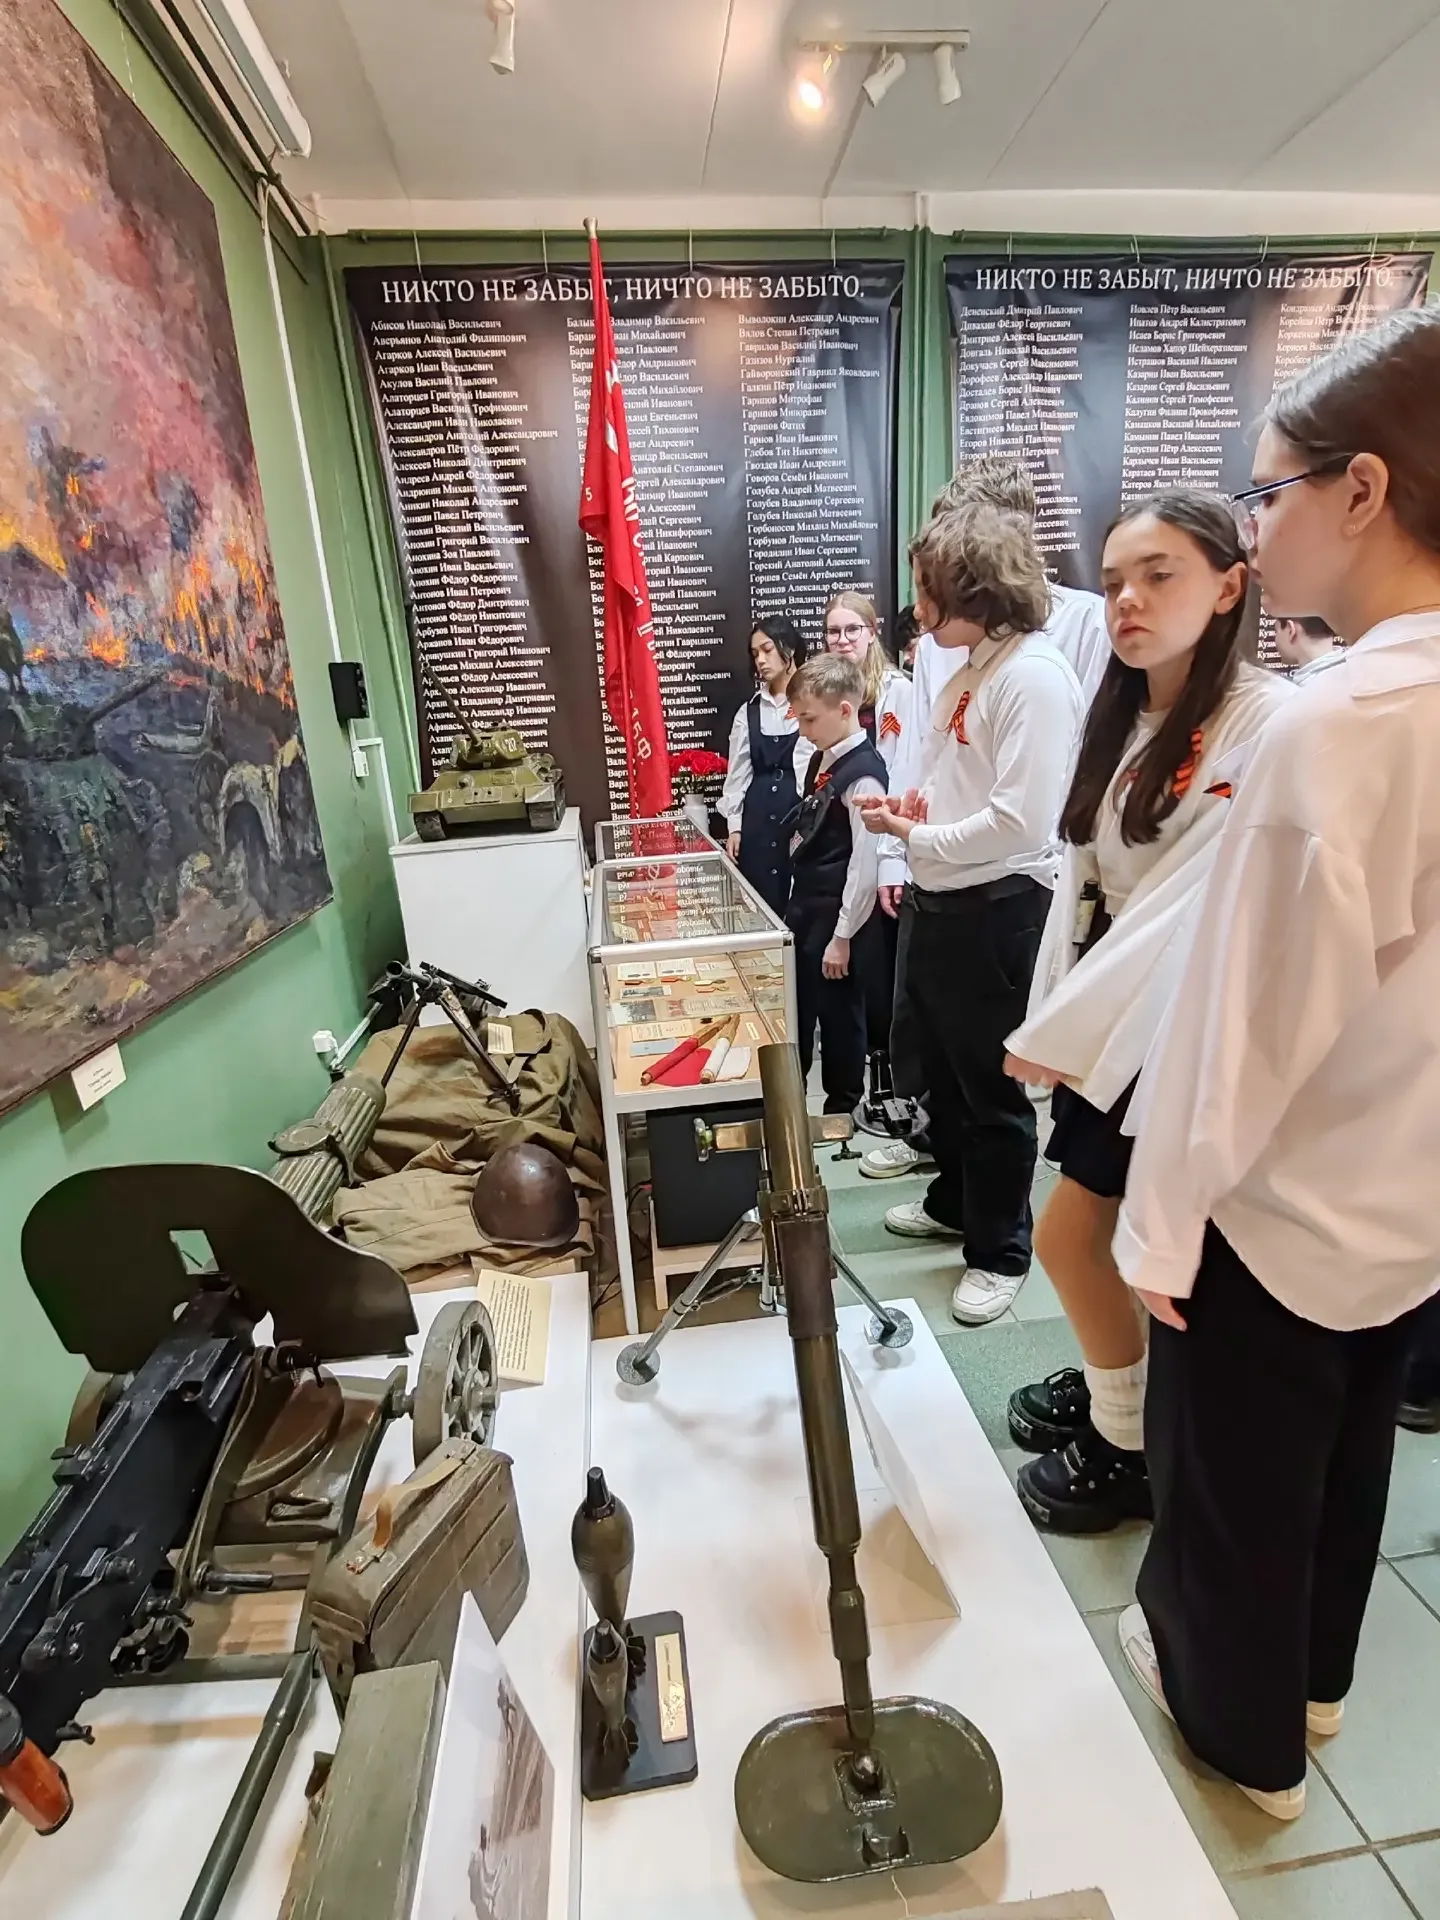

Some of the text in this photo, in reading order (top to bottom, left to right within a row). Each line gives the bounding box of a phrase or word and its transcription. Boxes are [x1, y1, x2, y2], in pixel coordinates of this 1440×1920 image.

[976, 267, 1393, 292] НИКТО НЕ ЗАБЫТ, НИЧТО НЕ ЗАБЫТО.
[382, 280, 474, 303] НИКТО
[482, 280, 517, 300] НЕ
[625, 277, 712, 300] НИЧТО
[721, 277, 752, 298] НЕ
[759, 275, 864, 298] ЗАБЫТО.
[1160, 304, 1179, 315] Пётр
[1181, 305, 1225, 314] Васильевич
[655, 315, 705, 326] Васильевич
[789, 314, 834, 323] Александр
[836, 313, 879, 325] Андреевич
[1159, 319, 1188, 328] Андрей
[371, 320, 501, 331] Абисов Николай Васильевич
[631, 330, 685, 340] Михайлович
[767, 327, 797, 337] Степан
[800, 327, 839, 337] Петрович
[1129, 331, 1225, 341] Исаев Борис Григорьевич
[373, 333, 526, 347] Аверьянов Анатолий Филиппович
[960, 334, 1000, 344] Дмитриев
[637, 345, 678, 354] Павлович
[740, 340, 858, 353] Гаврилов Василий Иванович
[995, 346, 1030, 355] Николай
[1032, 346, 1077, 354] Васильевич
[375, 349, 506, 362] Агарков Алексей Васильевич
[378, 362, 493, 375] Агарков Иван Васильевич
[639, 359, 696, 369] Андрианович
[960, 359, 1078, 372] Докучаев Сергей Максимович
[640, 373, 689, 381] Васильевич
[802, 368, 837, 378] Гавриил
[839, 367, 880, 377] Яковлевич
[380, 376, 498, 390] Акулов Василий Павлович
[960, 372, 1082, 385] Дорофеев Александр Иванович
[650, 386, 703, 395] Михайлович
[774, 382, 794, 392] Пётр
[796, 381, 836, 389] Иванович
[1160, 382, 1185, 392] Сергей
[1186, 383, 1230, 391] Васильевич
[382, 390, 518, 404] Алаторцев Григорий Иванович
[651, 399, 693, 408] Иванович
[384, 403, 528, 418] Алаторцев Василий Трофимович
[445, 418, 468, 427] Иван
[470, 417, 522, 427] Николаевич
[650, 413, 698, 422] Евгеньевич
[654, 426, 699, 435] Тихонович
[388, 430, 558, 445] Александров Анатолий Александрович
[960, 436, 1061, 448] Егоров Николай Павлович
[648, 440, 693, 448] Андреевич
[1161, 444, 1179, 454] Пётр
[390, 444, 520, 458] Александров Пётр Фёдорович
[745, 447, 837, 457] Глебов Тит Никитович
[392, 458, 526, 471] Алексеев Николай Дмитриевич
[674, 464, 723, 472] Степанович
[394, 472, 514, 485] Андреев Андрей Фёдорович
[662, 477, 725, 486] Александрович
[746, 472, 848, 484] Говоров Семён Иванович
[746, 484, 857, 496] Голубев Андрей Матвеевич
[432, 499, 469, 508] Николай
[472, 498, 518, 507] Андреевич
[747, 496, 864, 510] Голубев Владимир Сергеевич
[659, 516, 701, 526] Сергеевич
[797, 523, 828, 532] Михаил
[831, 522, 878, 530] Михайлович
[656, 528, 712, 540] Никифорович
[403, 536, 530, 550] Анохин Григорий Васильевич
[405, 549, 501, 562] Анохина Зоя Павловна
[664, 553, 704, 563] Карпович
[750, 558, 870, 571] Горский Анатолий Алексеевич
[751, 582, 873, 596] Горшков Александр Фёдорович
[412, 599, 529, 612] Антонов Фёдор Дмитриевич
[415, 623, 527, 637] Арбузов Иван Григорьевич
[462, 694, 555, 706] Владимир Дмитриевич
[668, 730, 712, 740] Георгиевич
